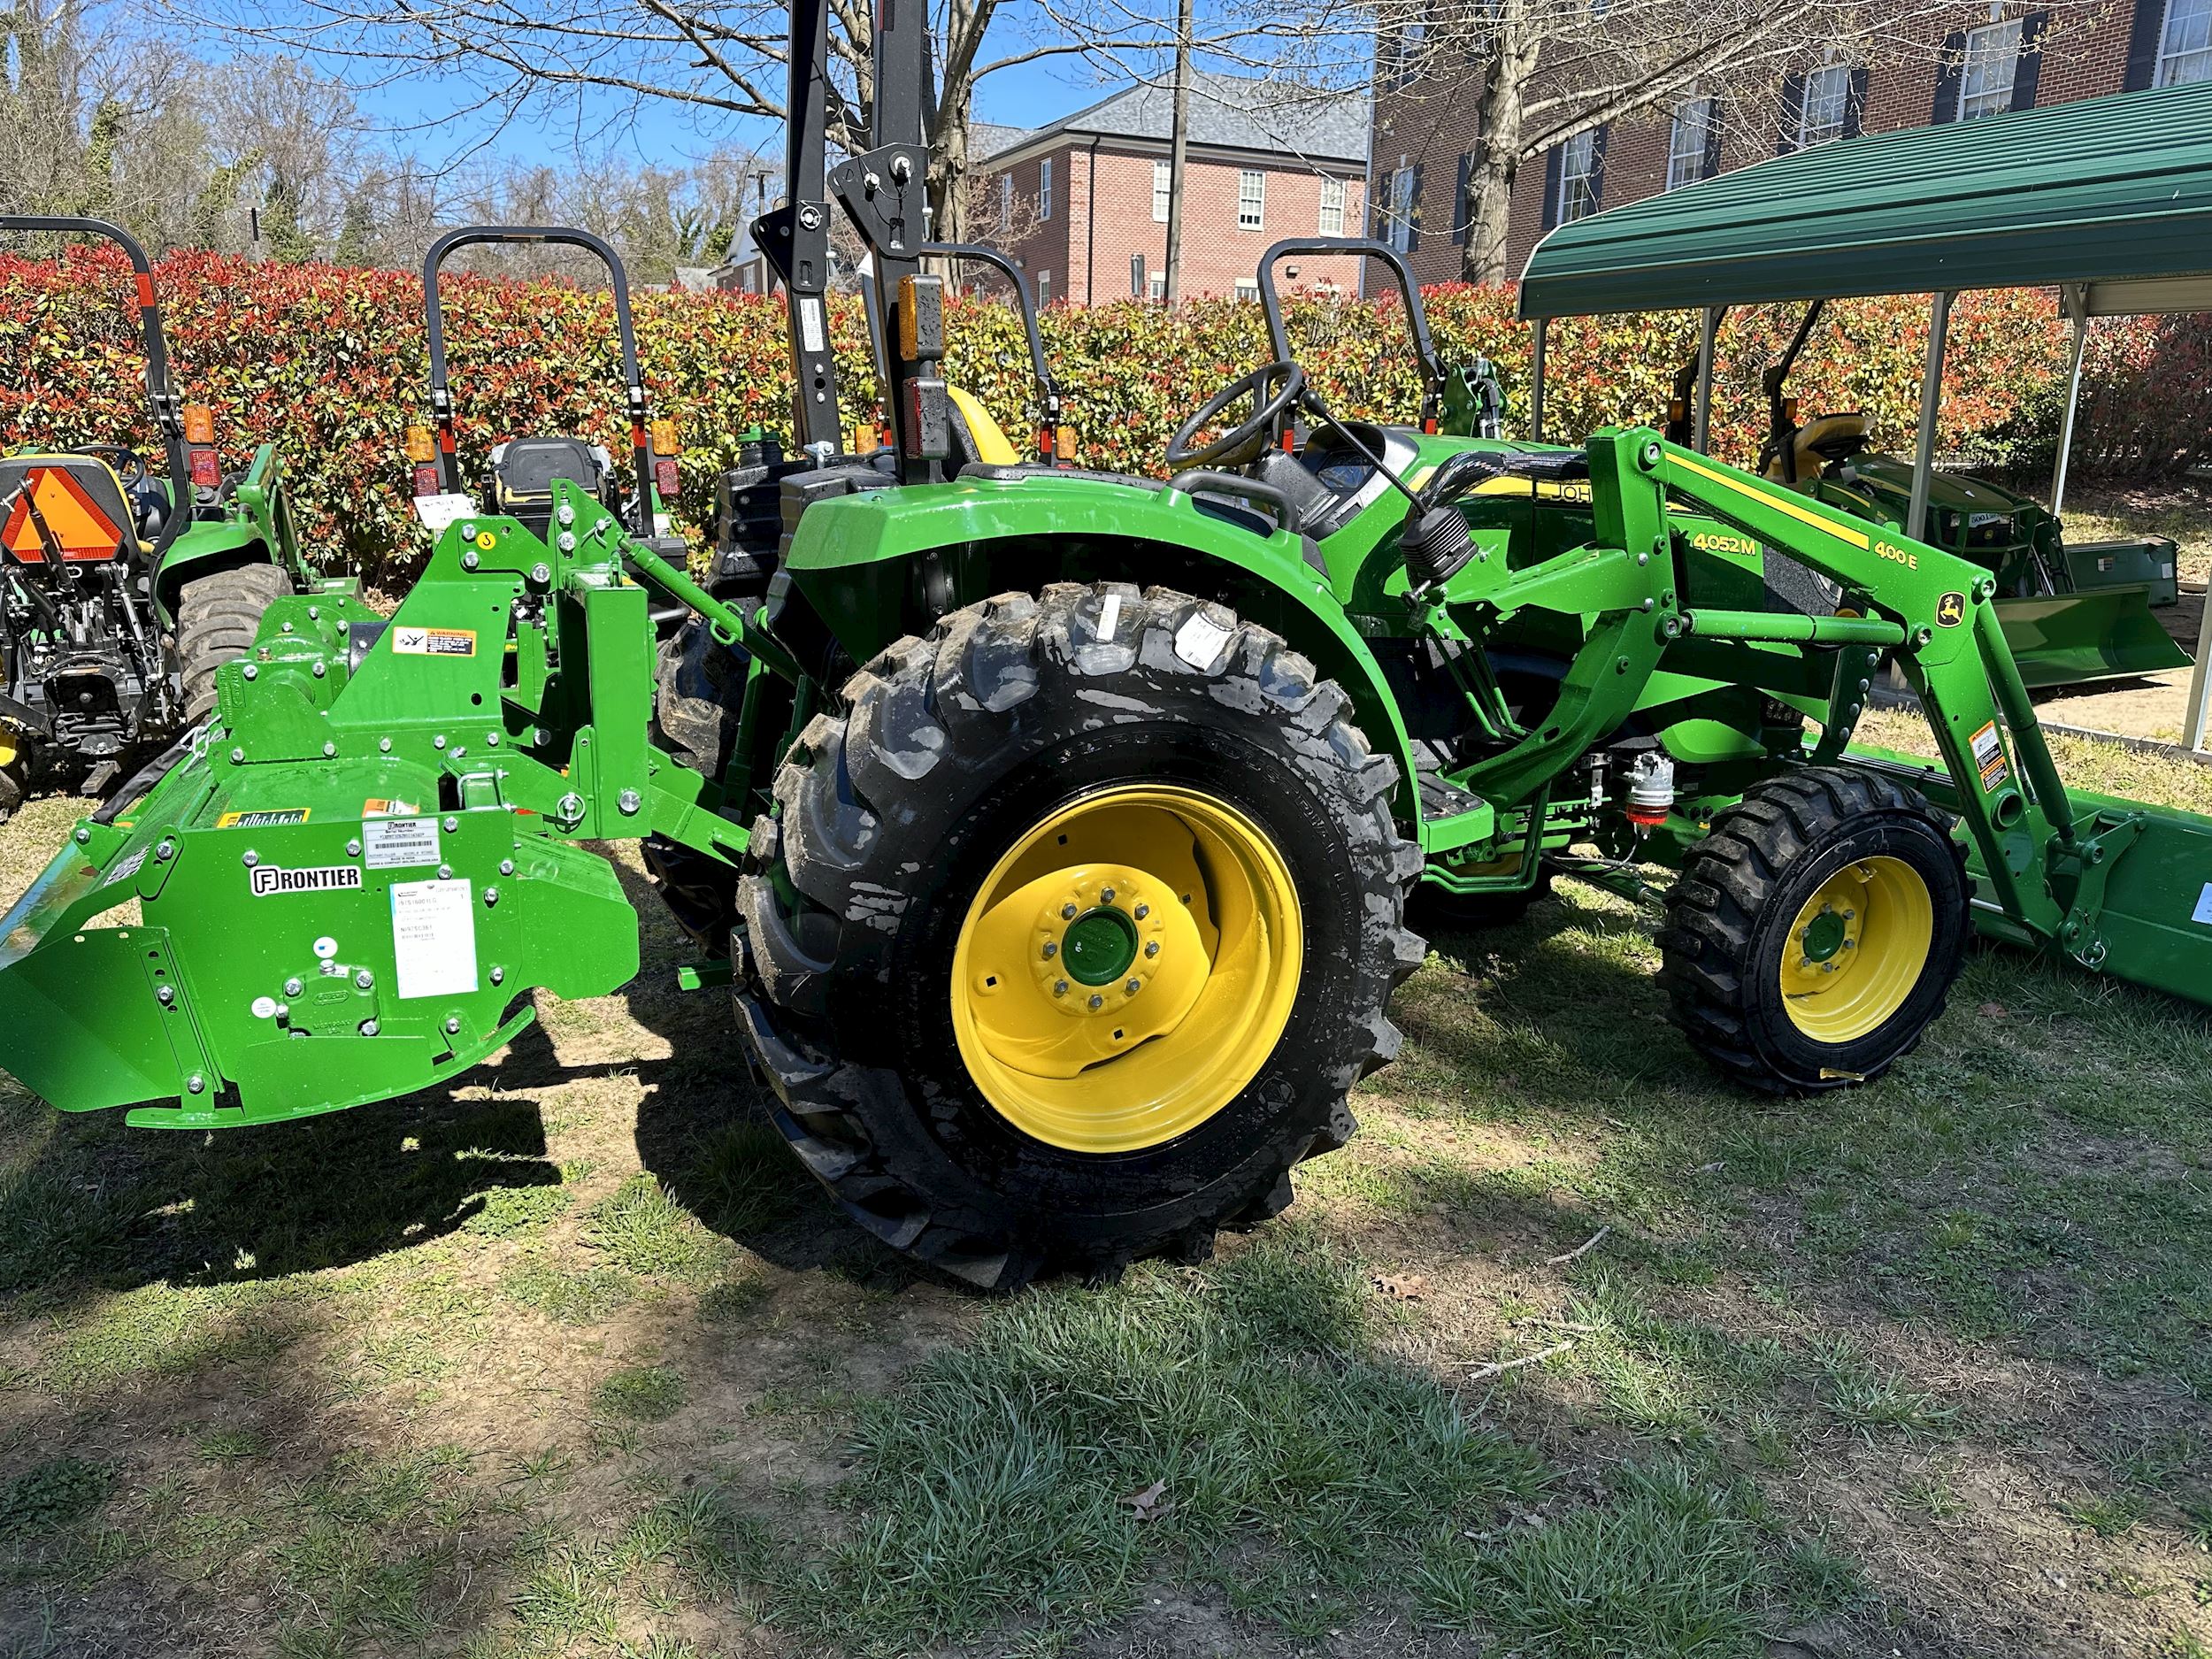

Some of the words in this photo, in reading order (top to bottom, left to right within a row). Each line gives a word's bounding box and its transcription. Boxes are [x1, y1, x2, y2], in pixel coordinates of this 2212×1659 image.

[1551, 480, 1592, 502] JOH
[1693, 533, 1756, 557] 4052M
[254, 869, 358, 894] FRONTIER
